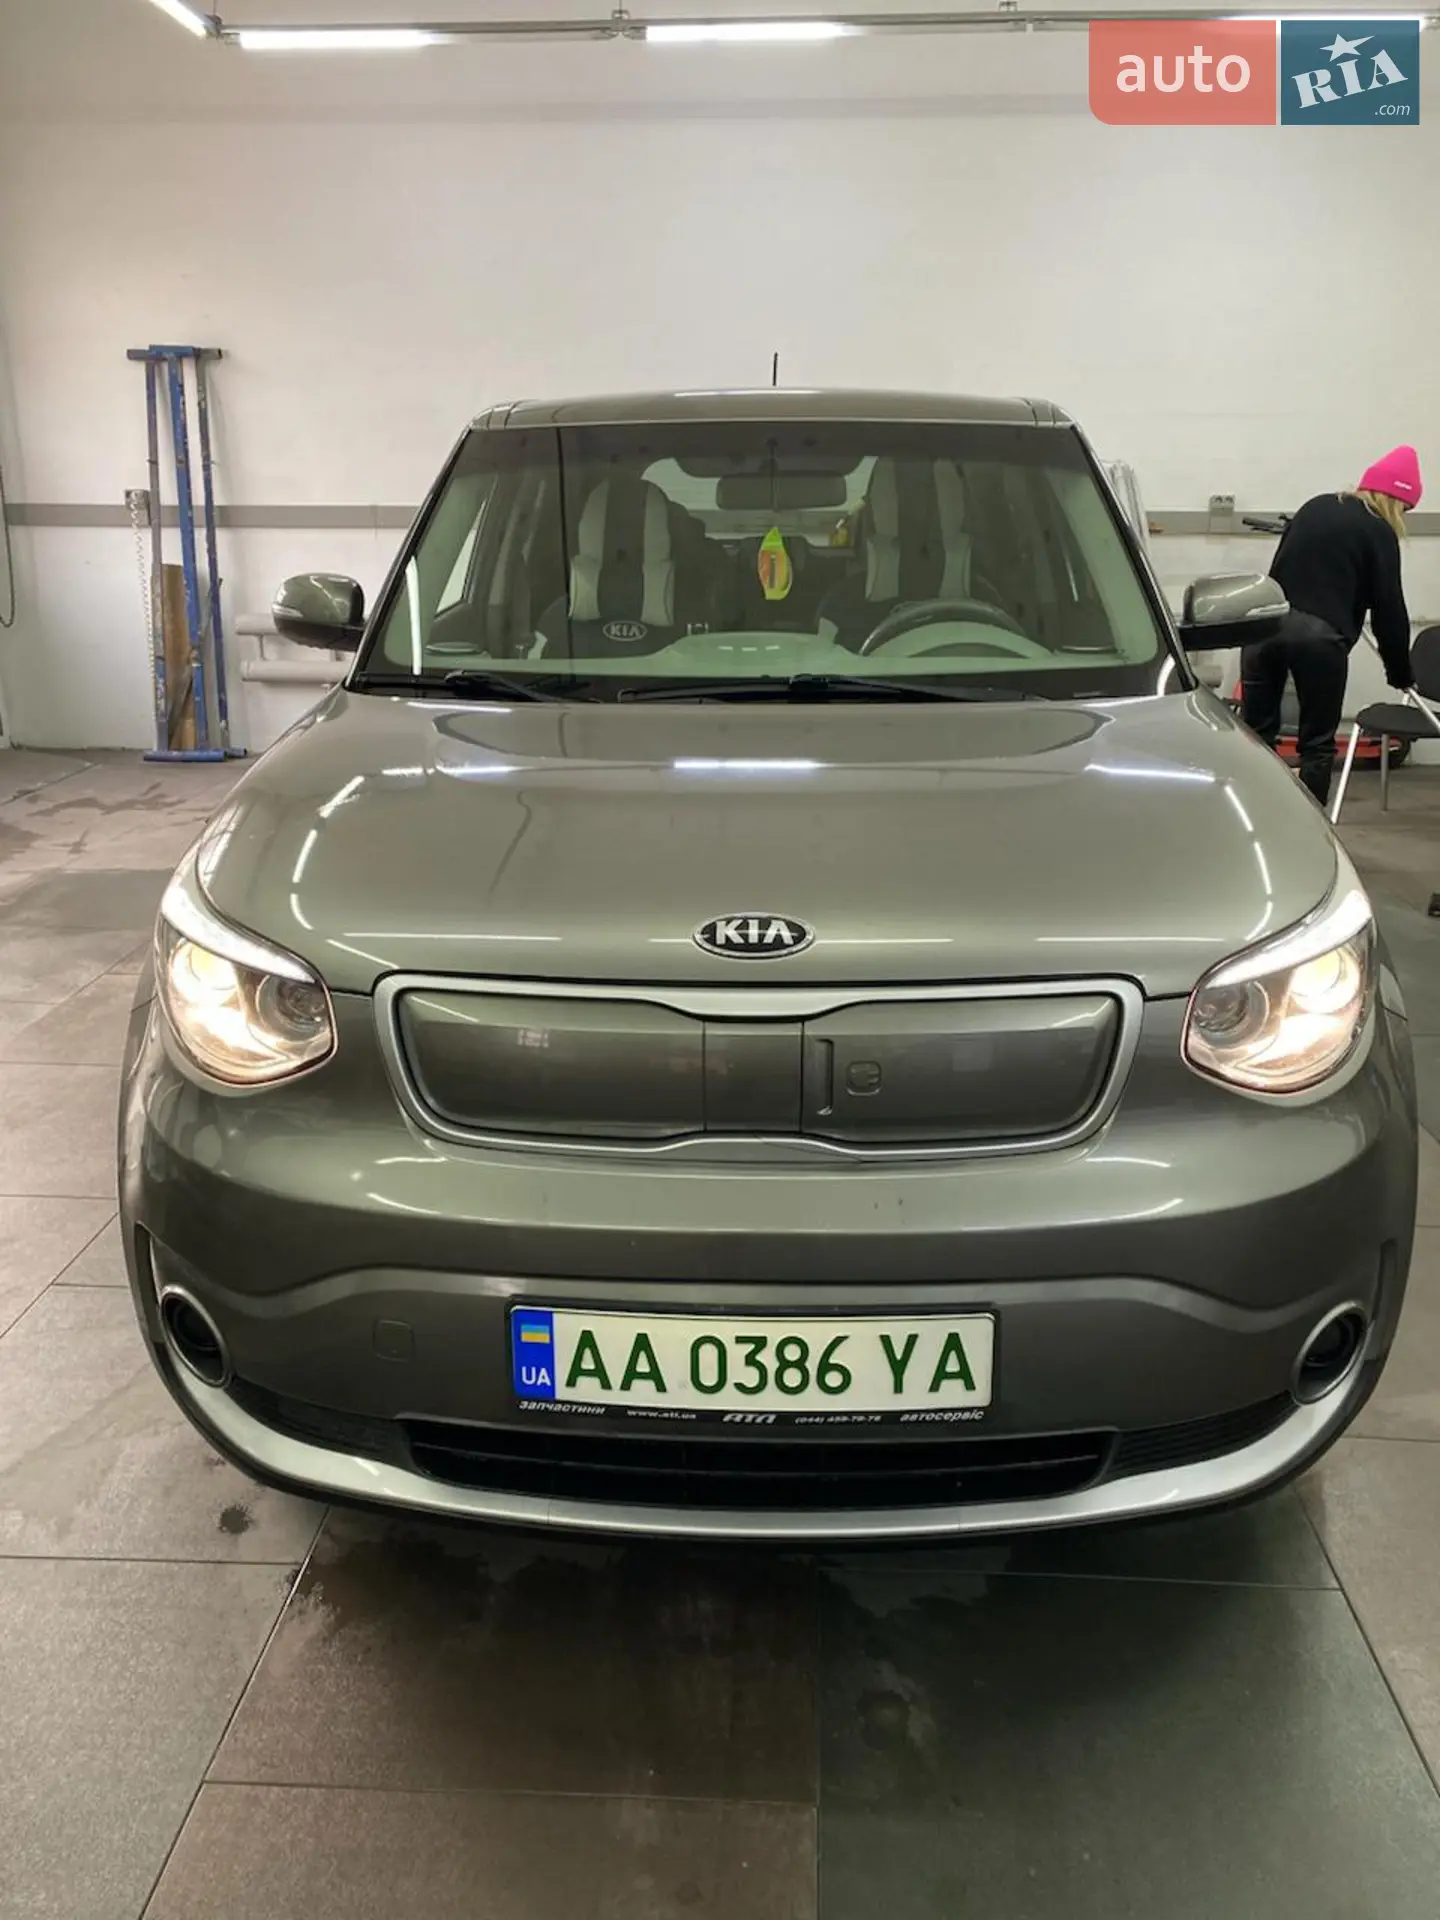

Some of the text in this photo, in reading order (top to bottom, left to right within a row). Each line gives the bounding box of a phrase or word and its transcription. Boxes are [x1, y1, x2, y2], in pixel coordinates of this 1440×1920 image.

[610, 624, 641, 637] KIA
[715, 919, 794, 945] KIA
[565, 1329, 977, 1395] AA 0386 YA
[521, 1366, 552, 1386] UA
